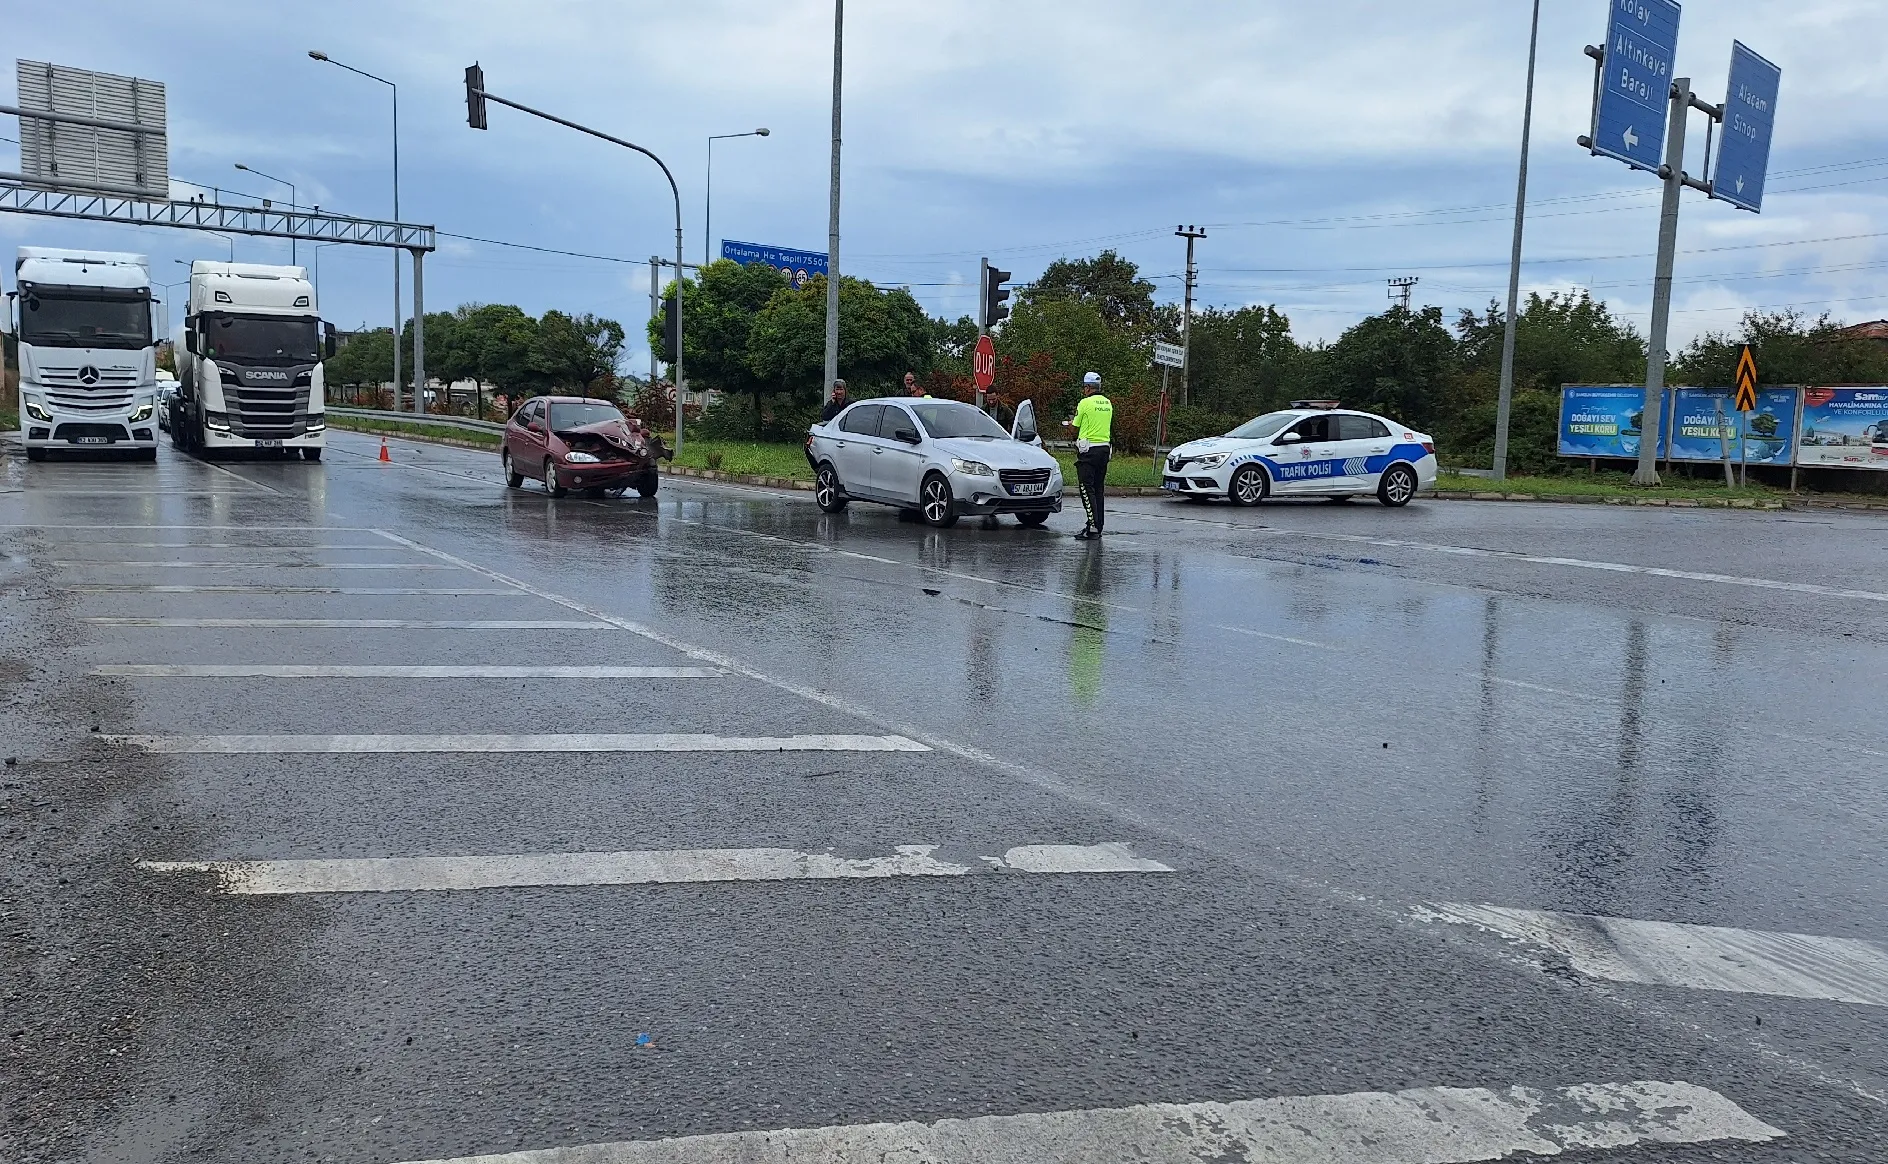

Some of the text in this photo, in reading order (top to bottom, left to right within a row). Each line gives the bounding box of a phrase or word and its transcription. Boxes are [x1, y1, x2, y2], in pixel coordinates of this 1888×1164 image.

[1620, 0, 1650, 26] Kolay
[1615, 34, 1666, 77] Altınkaya
[1738, 82, 1767, 113] Alaçam
[1733, 113, 1756, 143] Sinop
[724, 245, 760, 258] Ortalama
[779, 252, 802, 265] Tespiti
[975, 351, 994, 376] DUR
[245, 371, 288, 380] SCANIA
[1571, 412, 1617, 423] DOĞAYI SEV
[1683, 414, 1715, 426] DOĞAYI
[1594, 424, 1617, 434] KORU
[1280, 461, 1332, 478] TRAFİK POLİSİ
